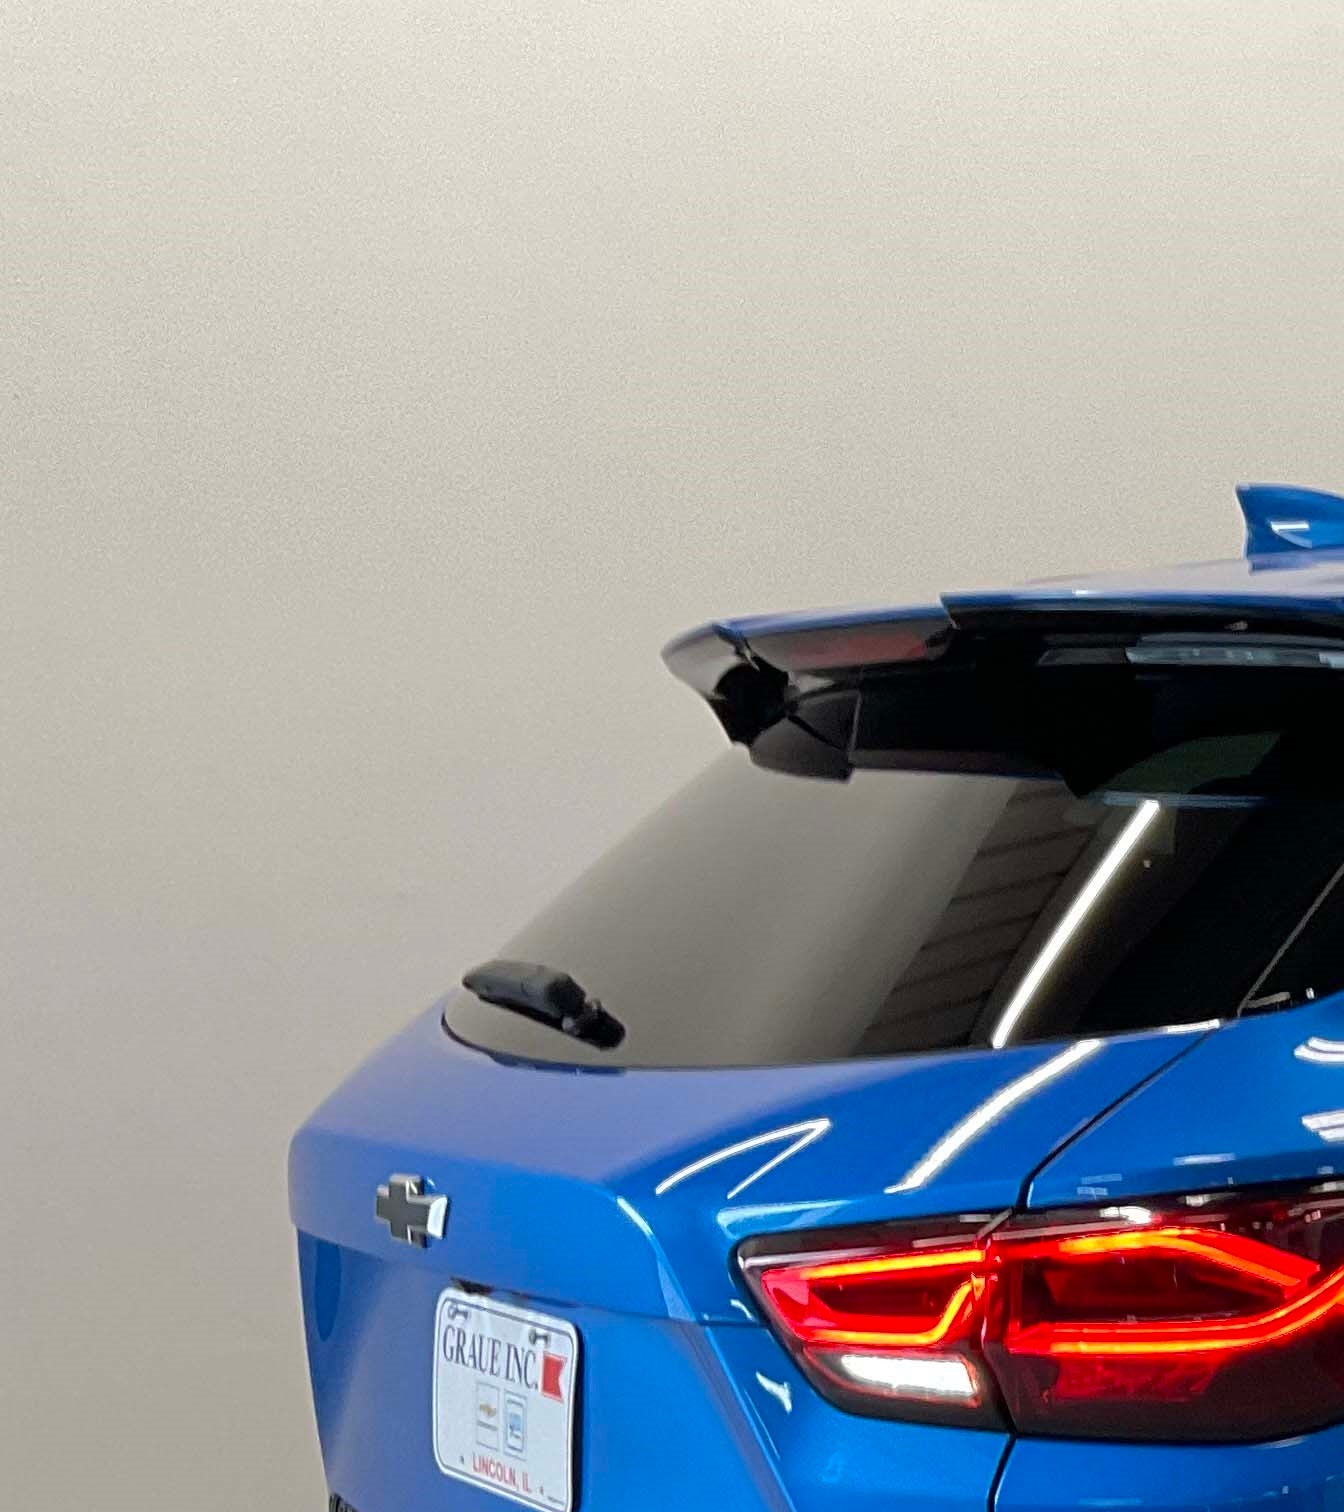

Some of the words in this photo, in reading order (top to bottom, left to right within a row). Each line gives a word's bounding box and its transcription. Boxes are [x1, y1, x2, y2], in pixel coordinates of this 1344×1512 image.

[443, 1324, 501, 1377] GRAUE
[505, 1342, 540, 1391] INC.
[471, 1452, 519, 1491] LINCOLN,
[521, 1472, 532, 1494] IL
